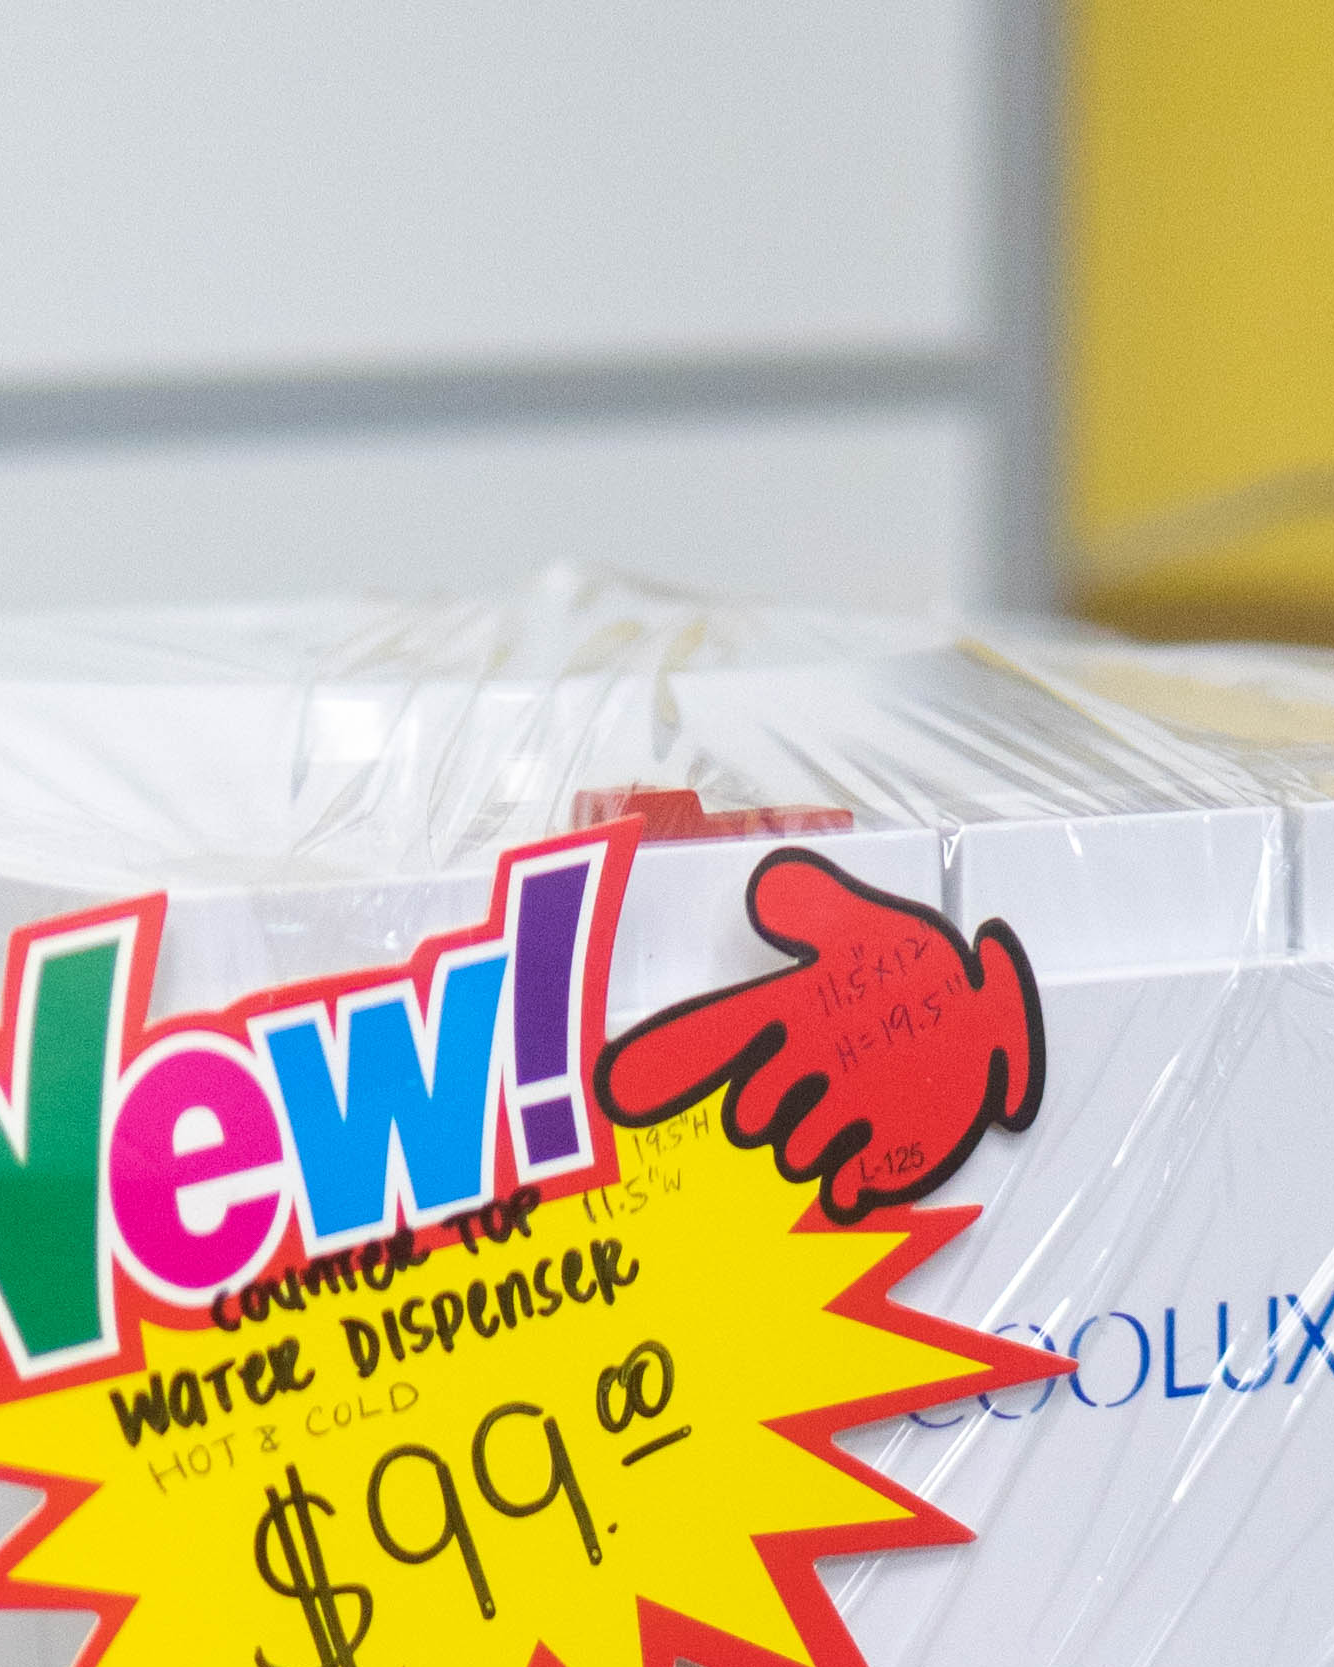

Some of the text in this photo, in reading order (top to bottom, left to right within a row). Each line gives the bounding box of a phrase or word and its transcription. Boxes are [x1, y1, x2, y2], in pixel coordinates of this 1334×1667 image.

[858, 1141, 926, 1184] L-125
[442, 1185, 542, 1255] TOP
[148, 1381, 419, 1496] HOT & COLD
